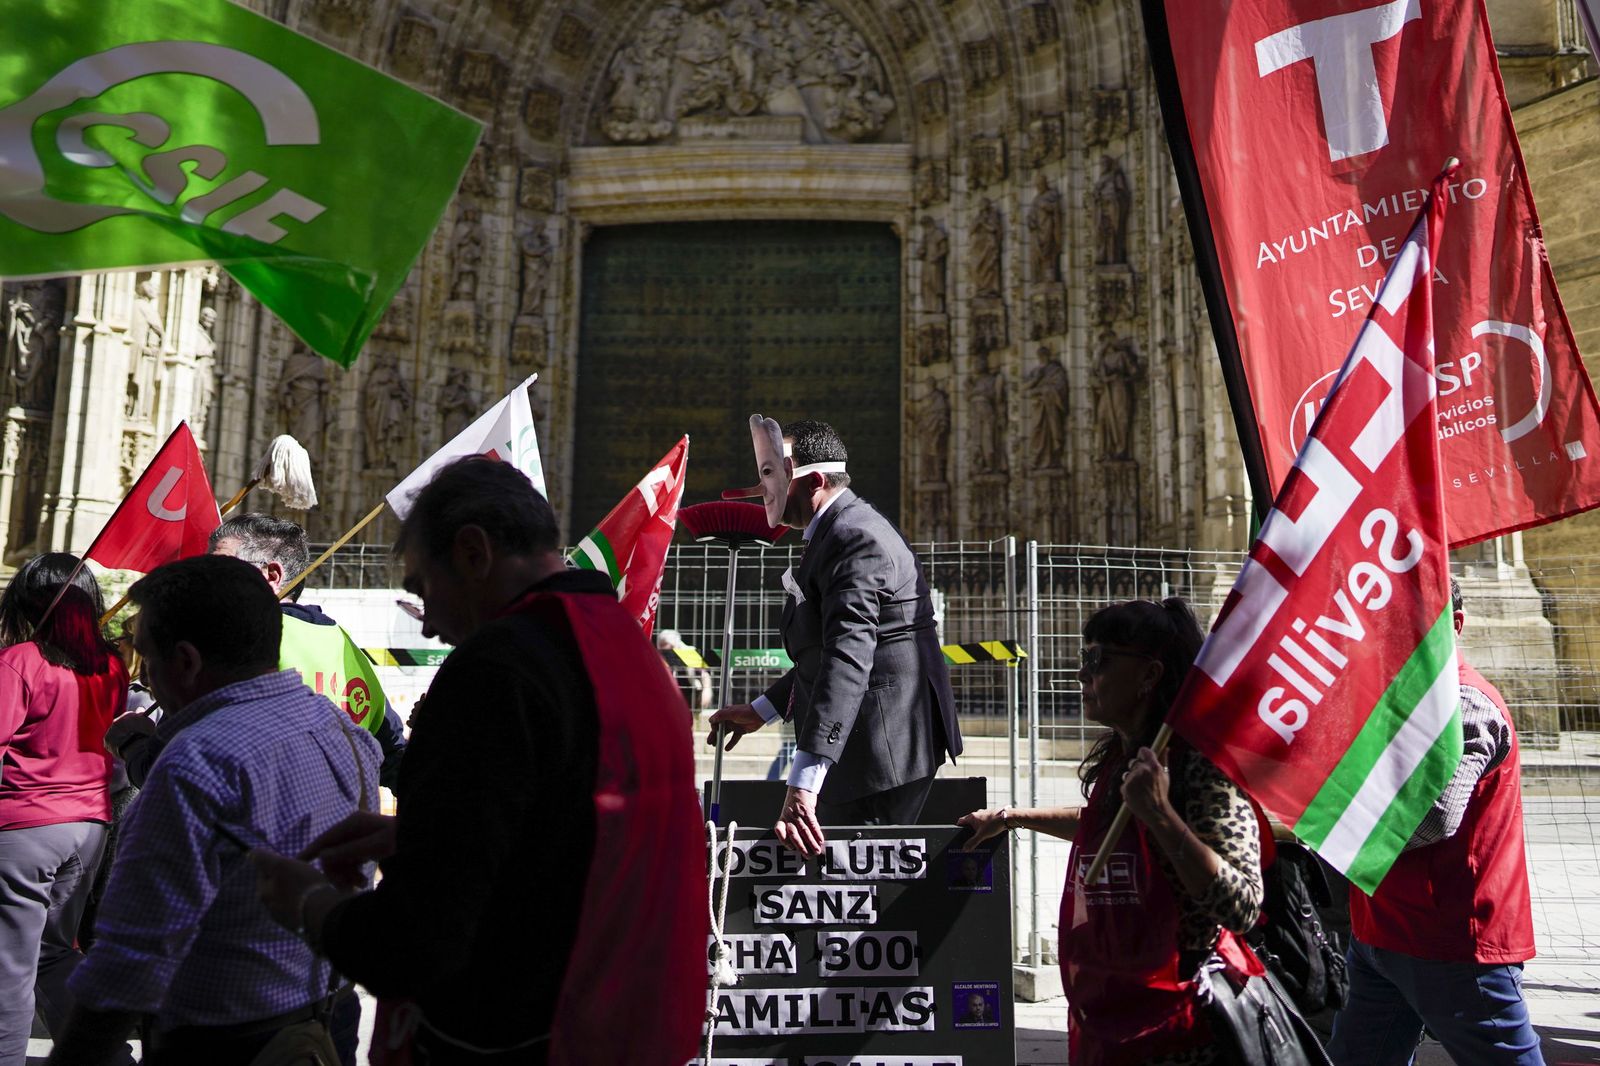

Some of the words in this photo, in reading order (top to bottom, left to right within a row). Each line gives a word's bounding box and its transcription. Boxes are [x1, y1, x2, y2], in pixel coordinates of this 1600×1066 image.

[1356, 236, 1398, 269] DE
[1452, 451, 1559, 488] SEVILLA
[734, 650, 780, 667] sando
[825, 844, 923, 876] LUIS
[760, 889, 871, 921] SANZ
[825, 935, 914, 972] 300
